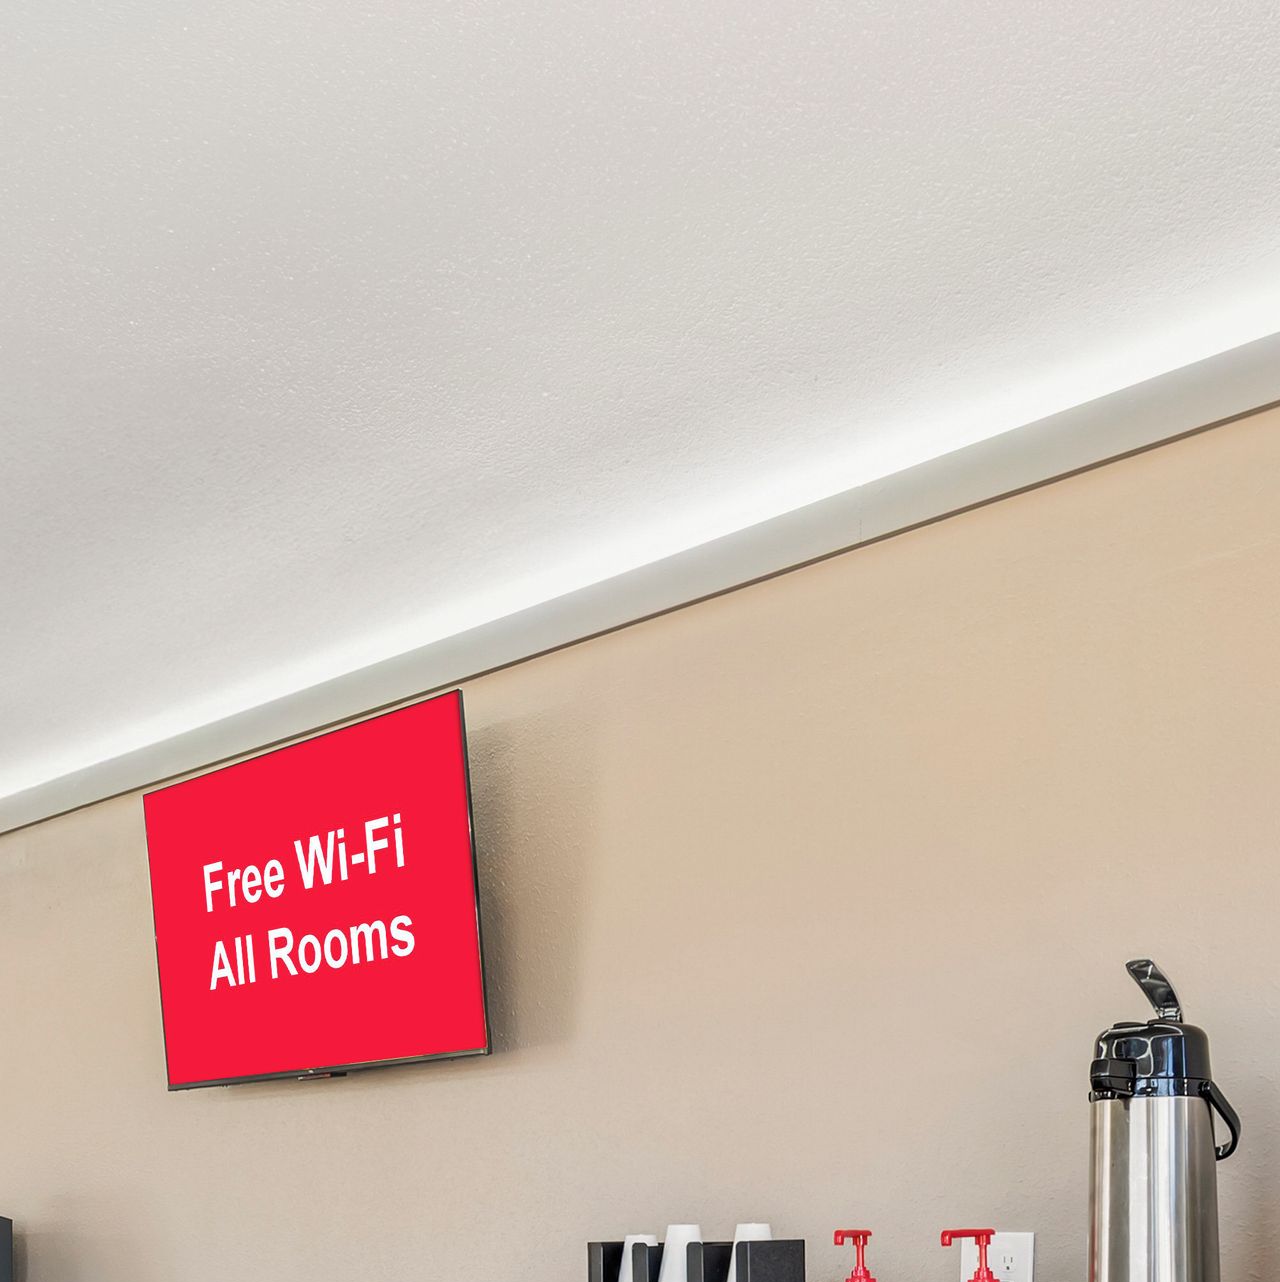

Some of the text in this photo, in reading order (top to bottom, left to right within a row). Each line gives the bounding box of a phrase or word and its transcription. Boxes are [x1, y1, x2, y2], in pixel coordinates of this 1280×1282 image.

[203, 812, 405, 913] Free Wi-Fi
[209, 914, 415, 991] All Rooms
